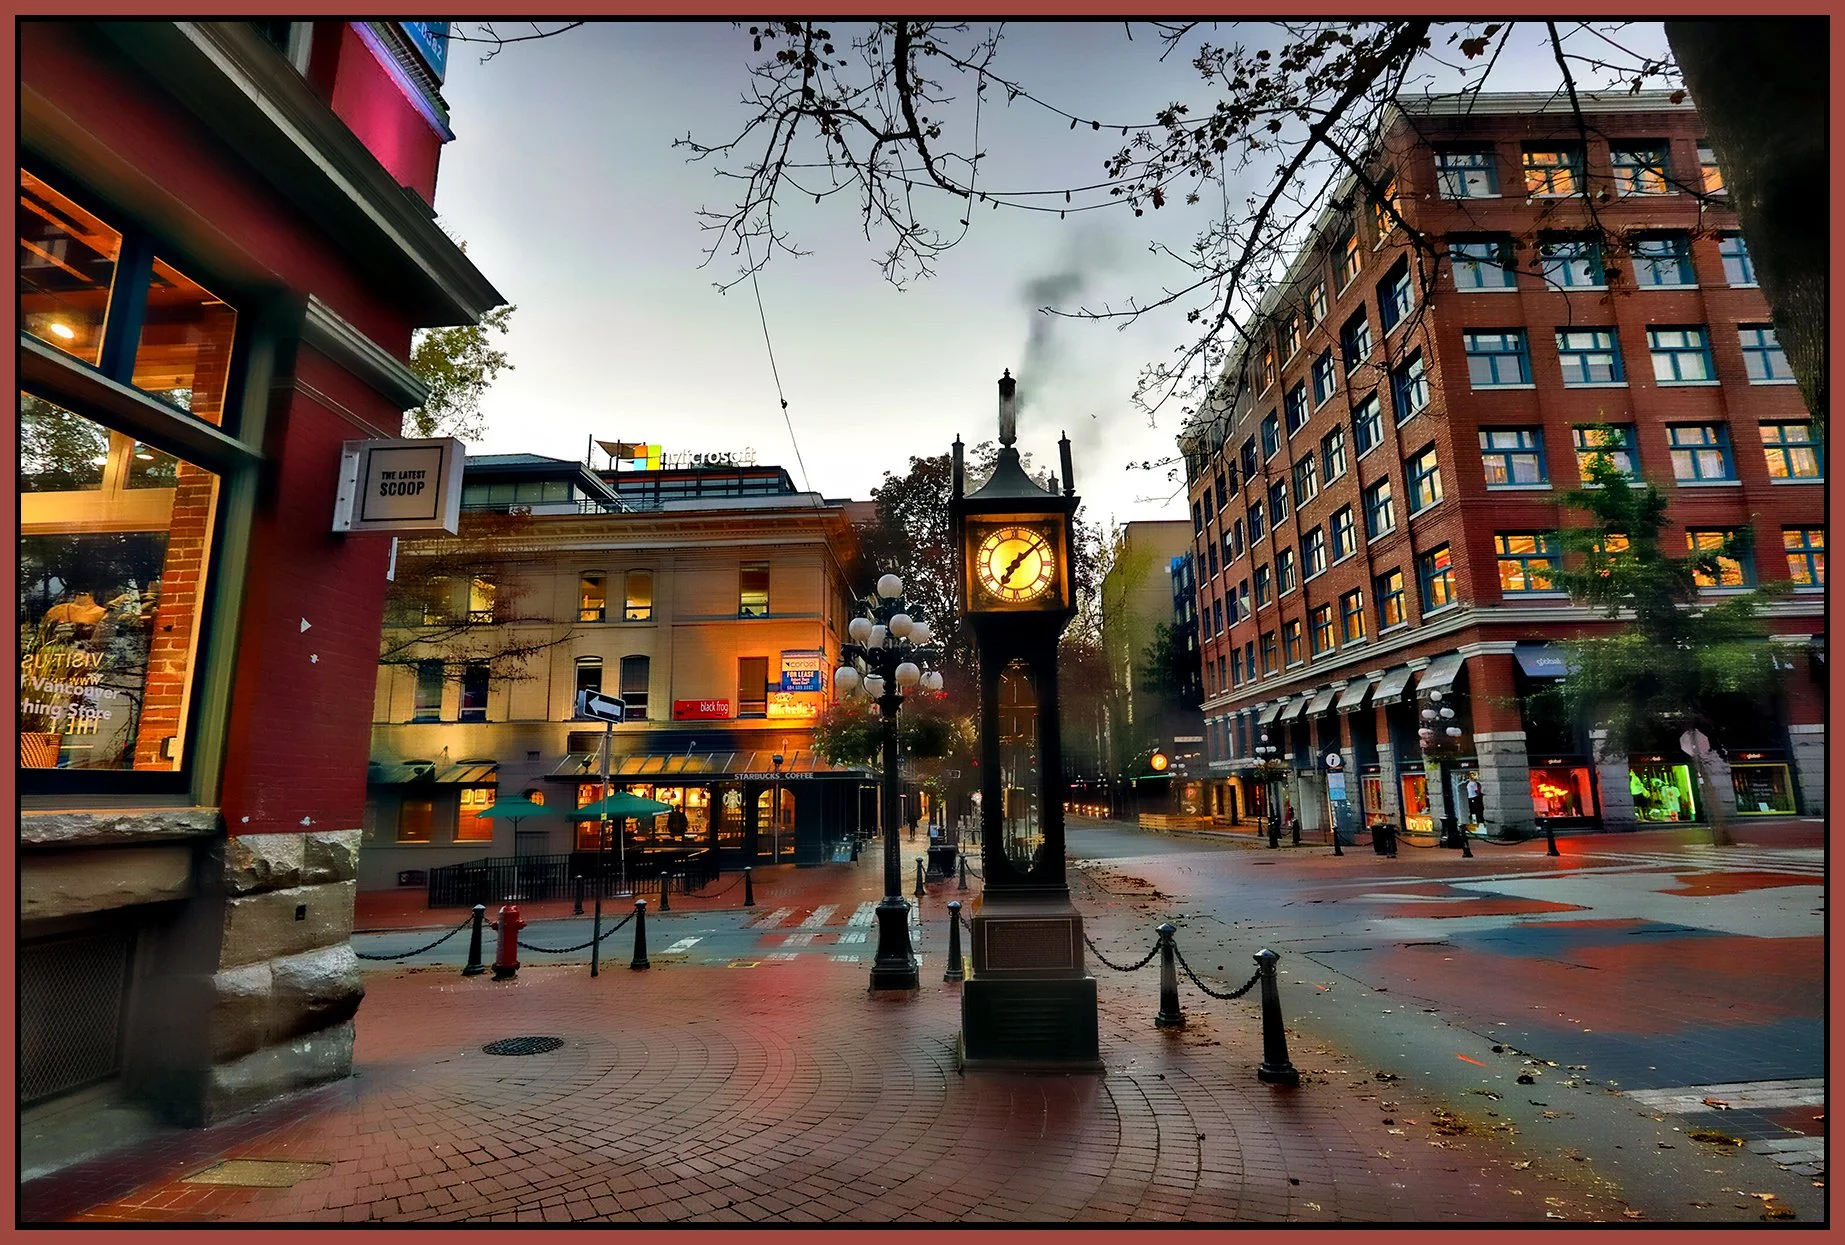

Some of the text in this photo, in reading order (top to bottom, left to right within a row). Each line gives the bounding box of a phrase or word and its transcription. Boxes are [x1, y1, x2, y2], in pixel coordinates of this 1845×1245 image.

[666, 446, 757, 465] Microsoft
[382, 470, 426, 480] THE LATEST
[380, 481, 425, 496] SCOOP
[32, 676, 120, 699] Vancouver
[68, 703, 112, 720] Store
[700, 701, 728, 714] black frog
[769, 702, 817, 715] Michelle's
